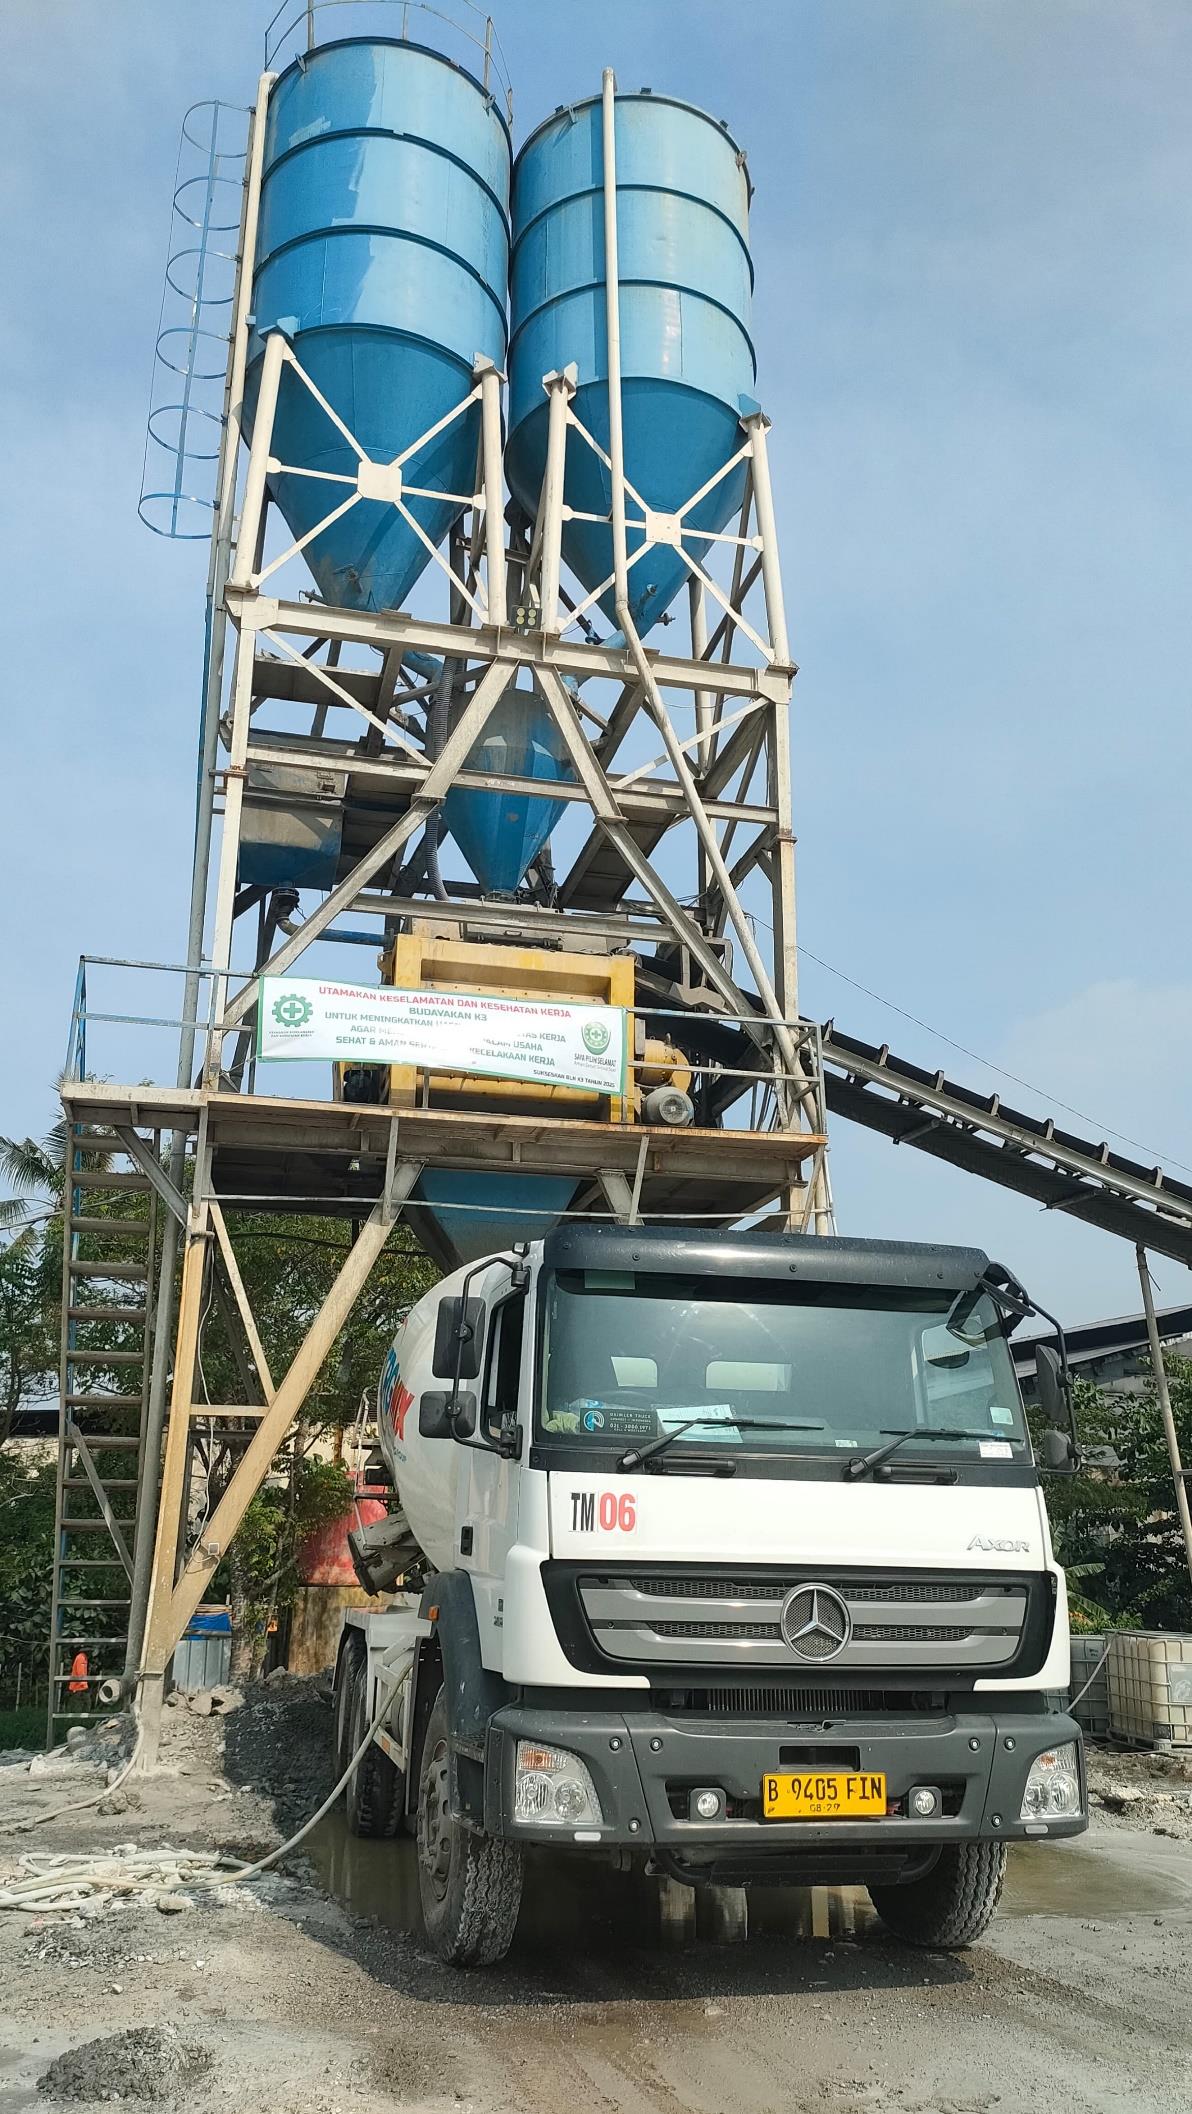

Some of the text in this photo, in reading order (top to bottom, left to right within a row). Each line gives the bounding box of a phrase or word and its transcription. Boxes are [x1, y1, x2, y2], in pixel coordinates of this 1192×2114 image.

[319, 987, 571, 1018] UTAMAKAN KESELAMATAN DAN KESEHATAN KERJA
[325, 1011, 358, 1021] UNTUK
[360, 1013, 433, 1027] MENINGKATKAN
[539, 1032, 566, 1043] KERJA
[474, 1013, 487, 1022] K3
[336, 1036, 366, 1045] SEHAT
[529, 1055, 556, 1067] KERJA
[350, 1025, 376, 1034] AGAR
[513, 1041, 543, 1052] USAHA
[585, 1077, 603, 1086] TAHUN
[570, 1491, 636, 1532] TM 06
[966, 1534, 1030, 1552] AXOR
[768, 1776, 882, 1801] B 9405 FIN
